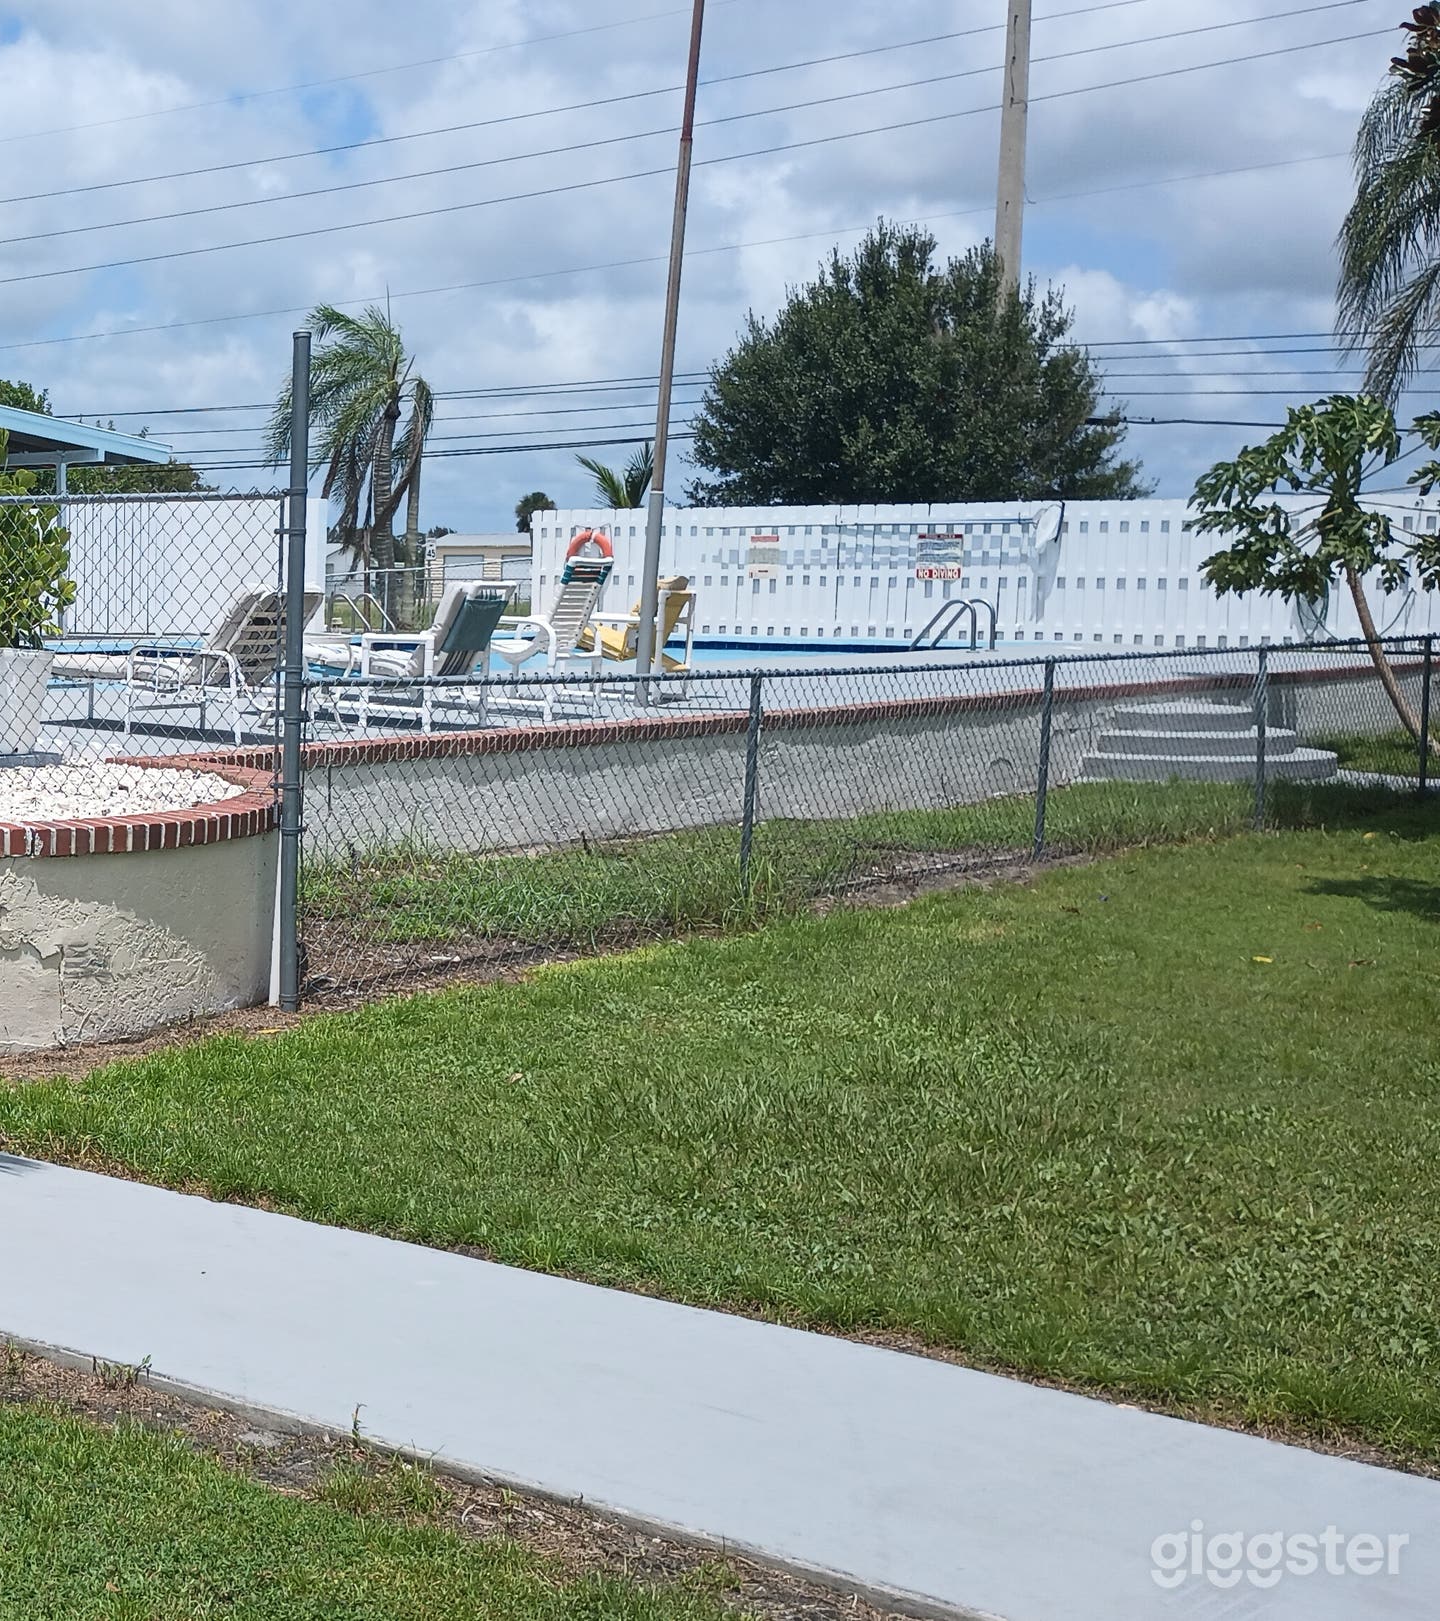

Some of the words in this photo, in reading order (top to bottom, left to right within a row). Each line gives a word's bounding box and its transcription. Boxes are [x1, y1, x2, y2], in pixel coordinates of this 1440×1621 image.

[427, 549, 435, 558] 45
[918, 568, 929, 579] NO
[932, 568, 958, 579] DIVING
